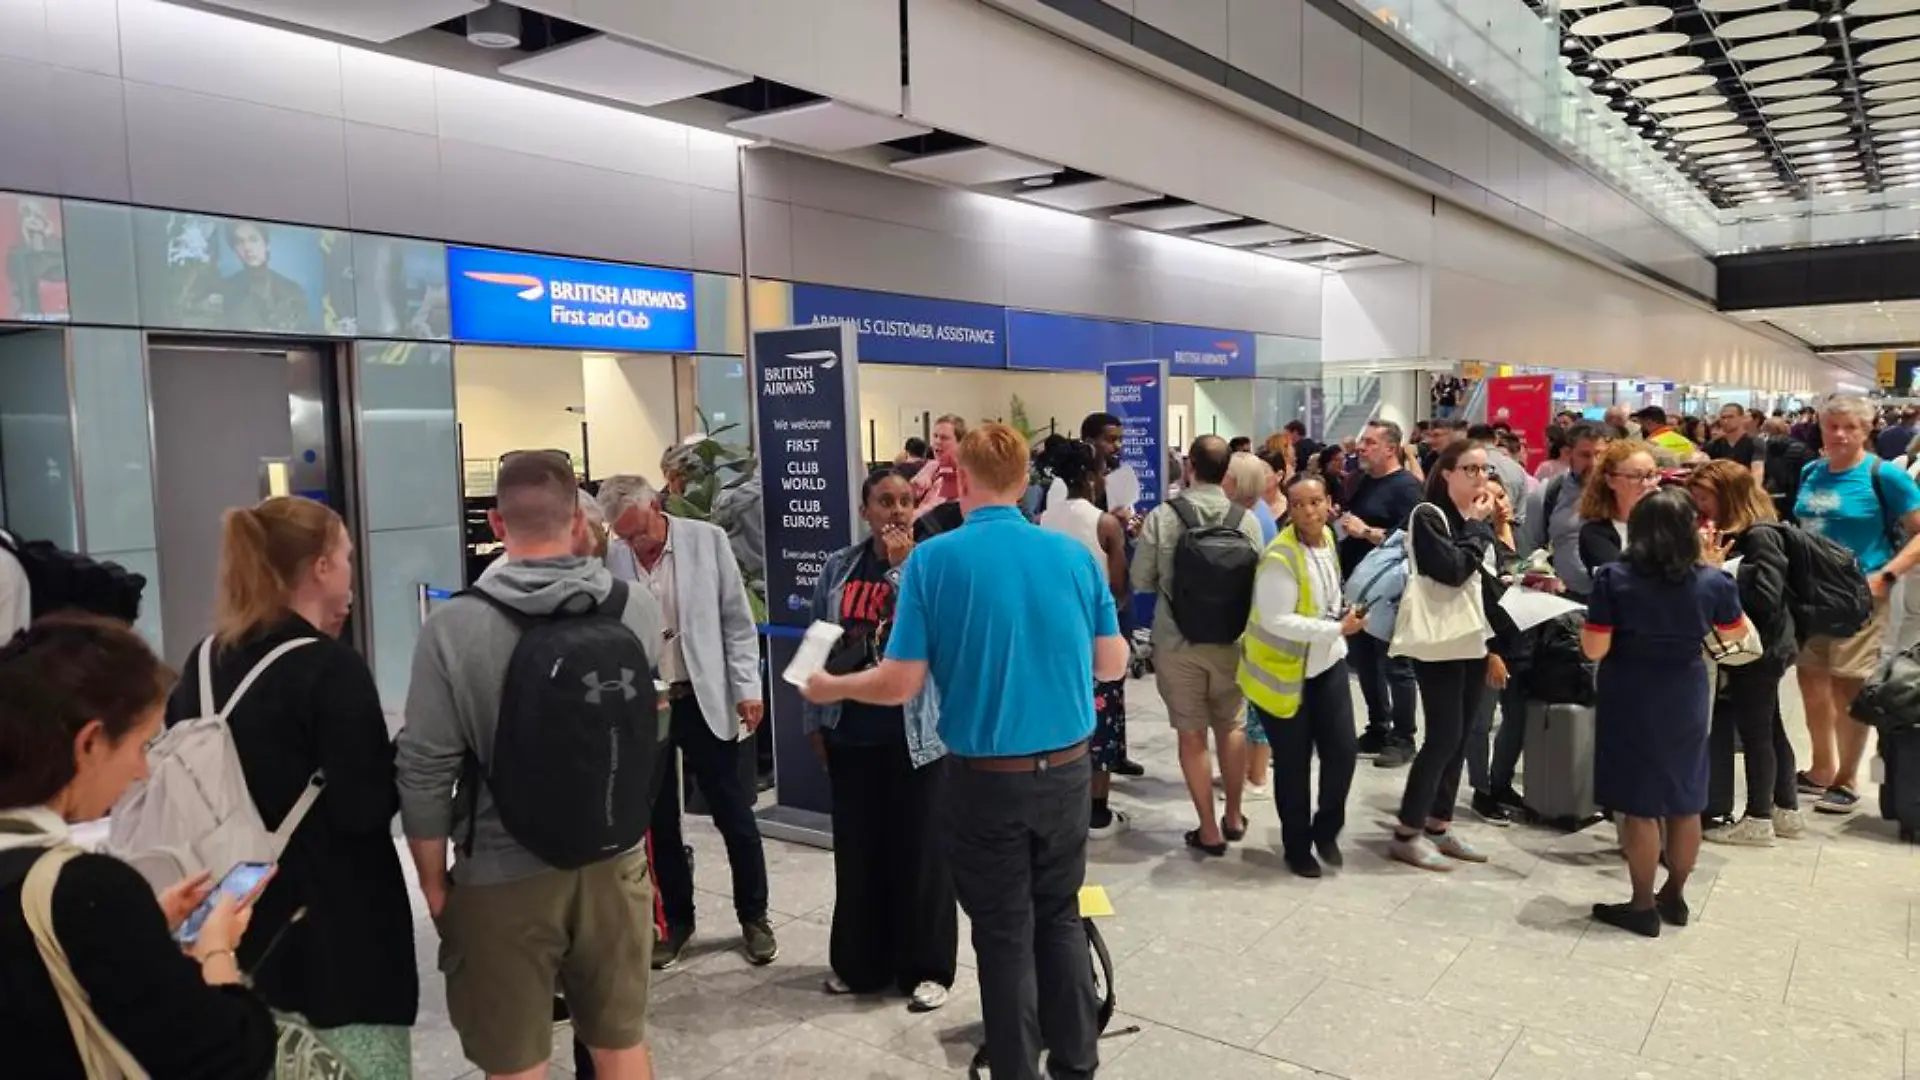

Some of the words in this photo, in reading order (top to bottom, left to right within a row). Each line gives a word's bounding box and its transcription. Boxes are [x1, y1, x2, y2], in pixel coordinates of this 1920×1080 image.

[550, 281, 619, 305] BRITISH
[621, 287, 687, 310] AIRWAYS
[551, 305, 586, 325] First
[588, 310, 614, 327] and
[617, 309, 650, 329] Club
[873, 319, 934, 340] CUSTOMER
[937, 326, 995, 344] ASSISTANCE
[764, 366, 813, 381] BRITISH
[763, 381, 815, 396] AIRWAYS
[773, 419, 788, 430] We
[791, 417, 832, 430] welcome
[786, 439, 819, 453] FIRST
[787, 461, 818, 474] CLUB
[781, 477, 826, 490] WORLD
[789, 499, 820, 512] CLUB
[783, 515, 830, 529] EUROPE
[796, 561, 822, 573] GOLD
[796, 575, 819, 586] SILVE
